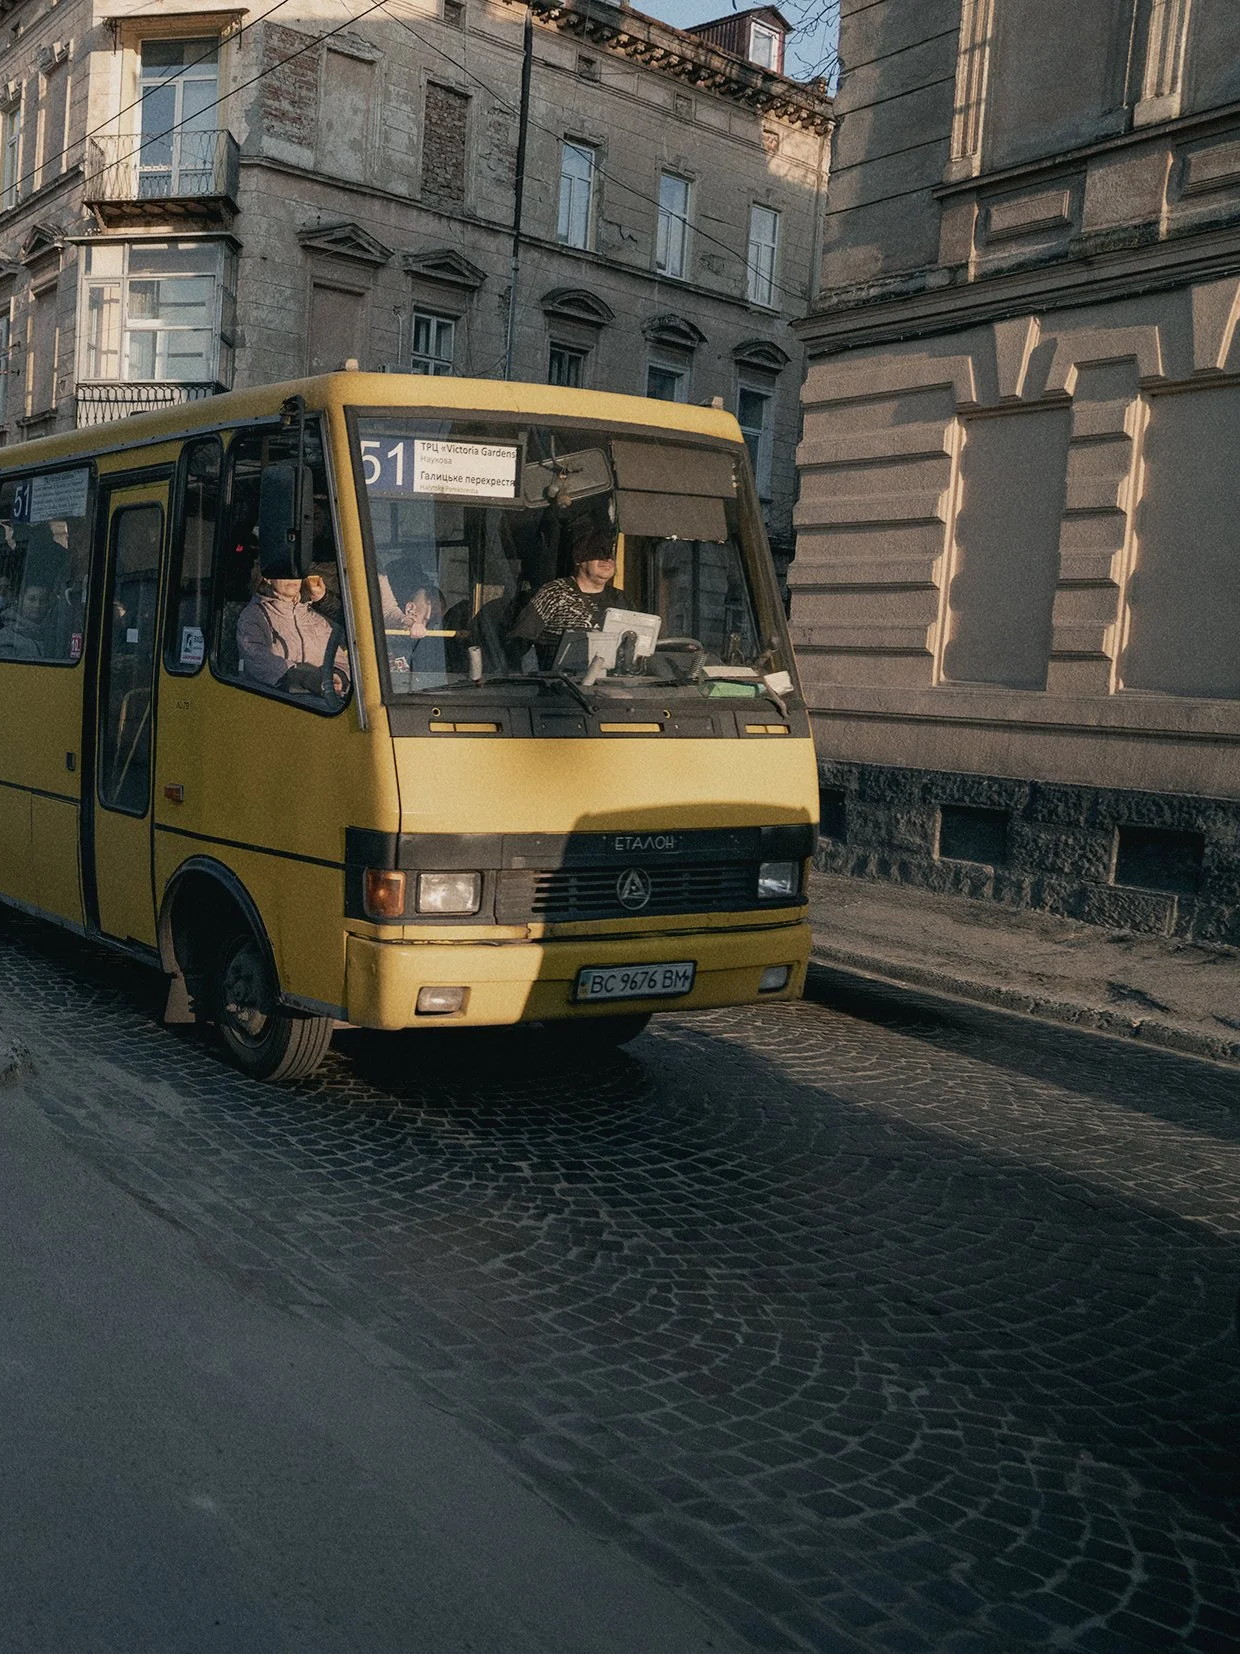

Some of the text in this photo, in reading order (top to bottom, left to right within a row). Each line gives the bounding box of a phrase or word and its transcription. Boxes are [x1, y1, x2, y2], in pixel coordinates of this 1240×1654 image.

[420, 442, 439, 453] ТРЦ
[440, 444, 479, 456] «Victoria
[360, 440, 404, 486] 51
[420, 455, 453, 465] Наукова
[420, 471, 515, 488] Галицьке перехрестя
[13, 484, 30, 517] 51
[615, 835, 674, 851] ЕТАЛОН
[590, 969, 688, 994] BC 9676 BM
